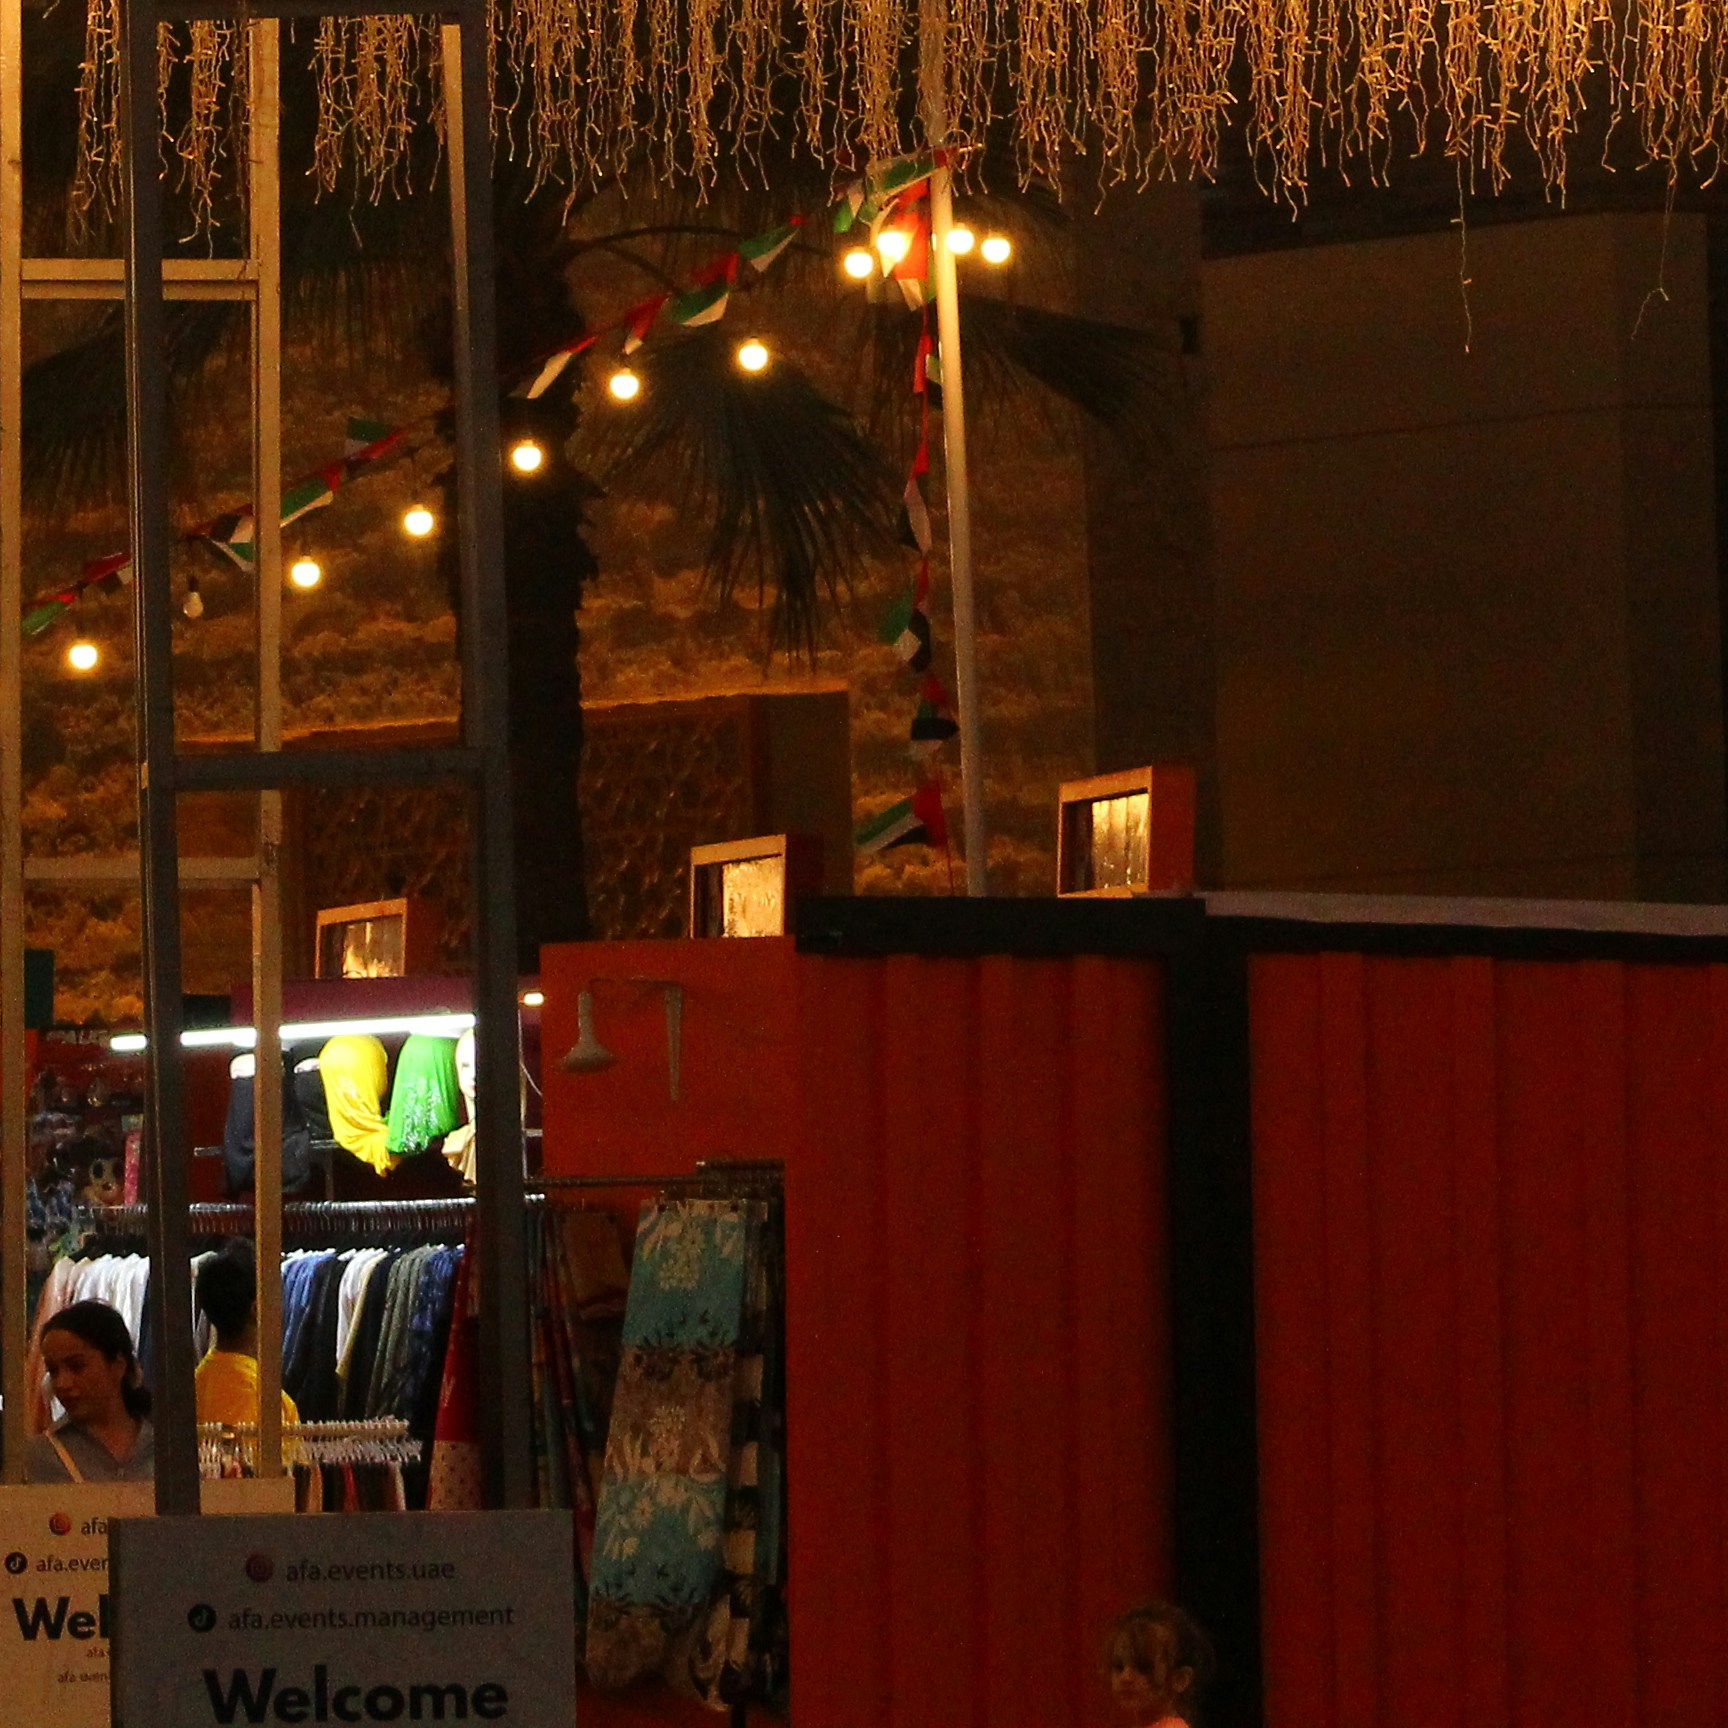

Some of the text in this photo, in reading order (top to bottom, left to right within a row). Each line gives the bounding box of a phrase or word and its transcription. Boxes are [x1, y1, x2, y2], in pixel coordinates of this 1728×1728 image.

[286, 1557, 456, 1582] afa.events.uae
[228, 1606, 515, 1633] afa.events.management
[203, 1664, 509, 1724] Welcome
